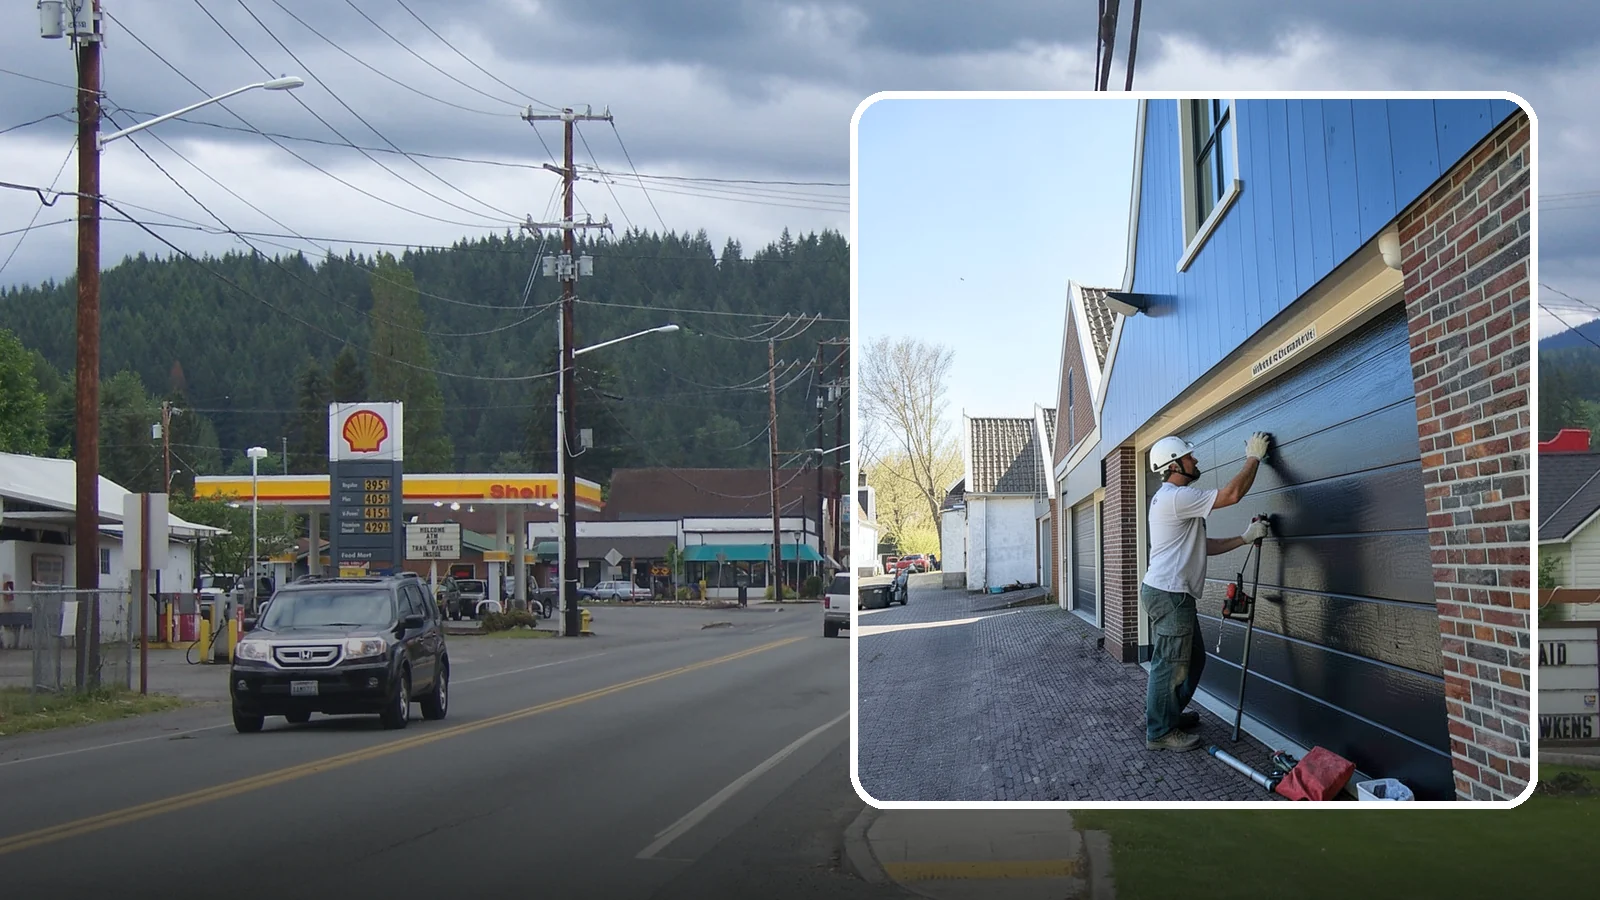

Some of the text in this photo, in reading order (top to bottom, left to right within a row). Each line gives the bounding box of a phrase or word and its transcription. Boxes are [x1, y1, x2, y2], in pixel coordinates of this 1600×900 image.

[366, 480, 383, 490] 395
[490, 484, 547, 499] Shell
[365, 494, 383, 504] 405
[365, 508, 383, 518] 415
[365, 522, 383, 532] 429
